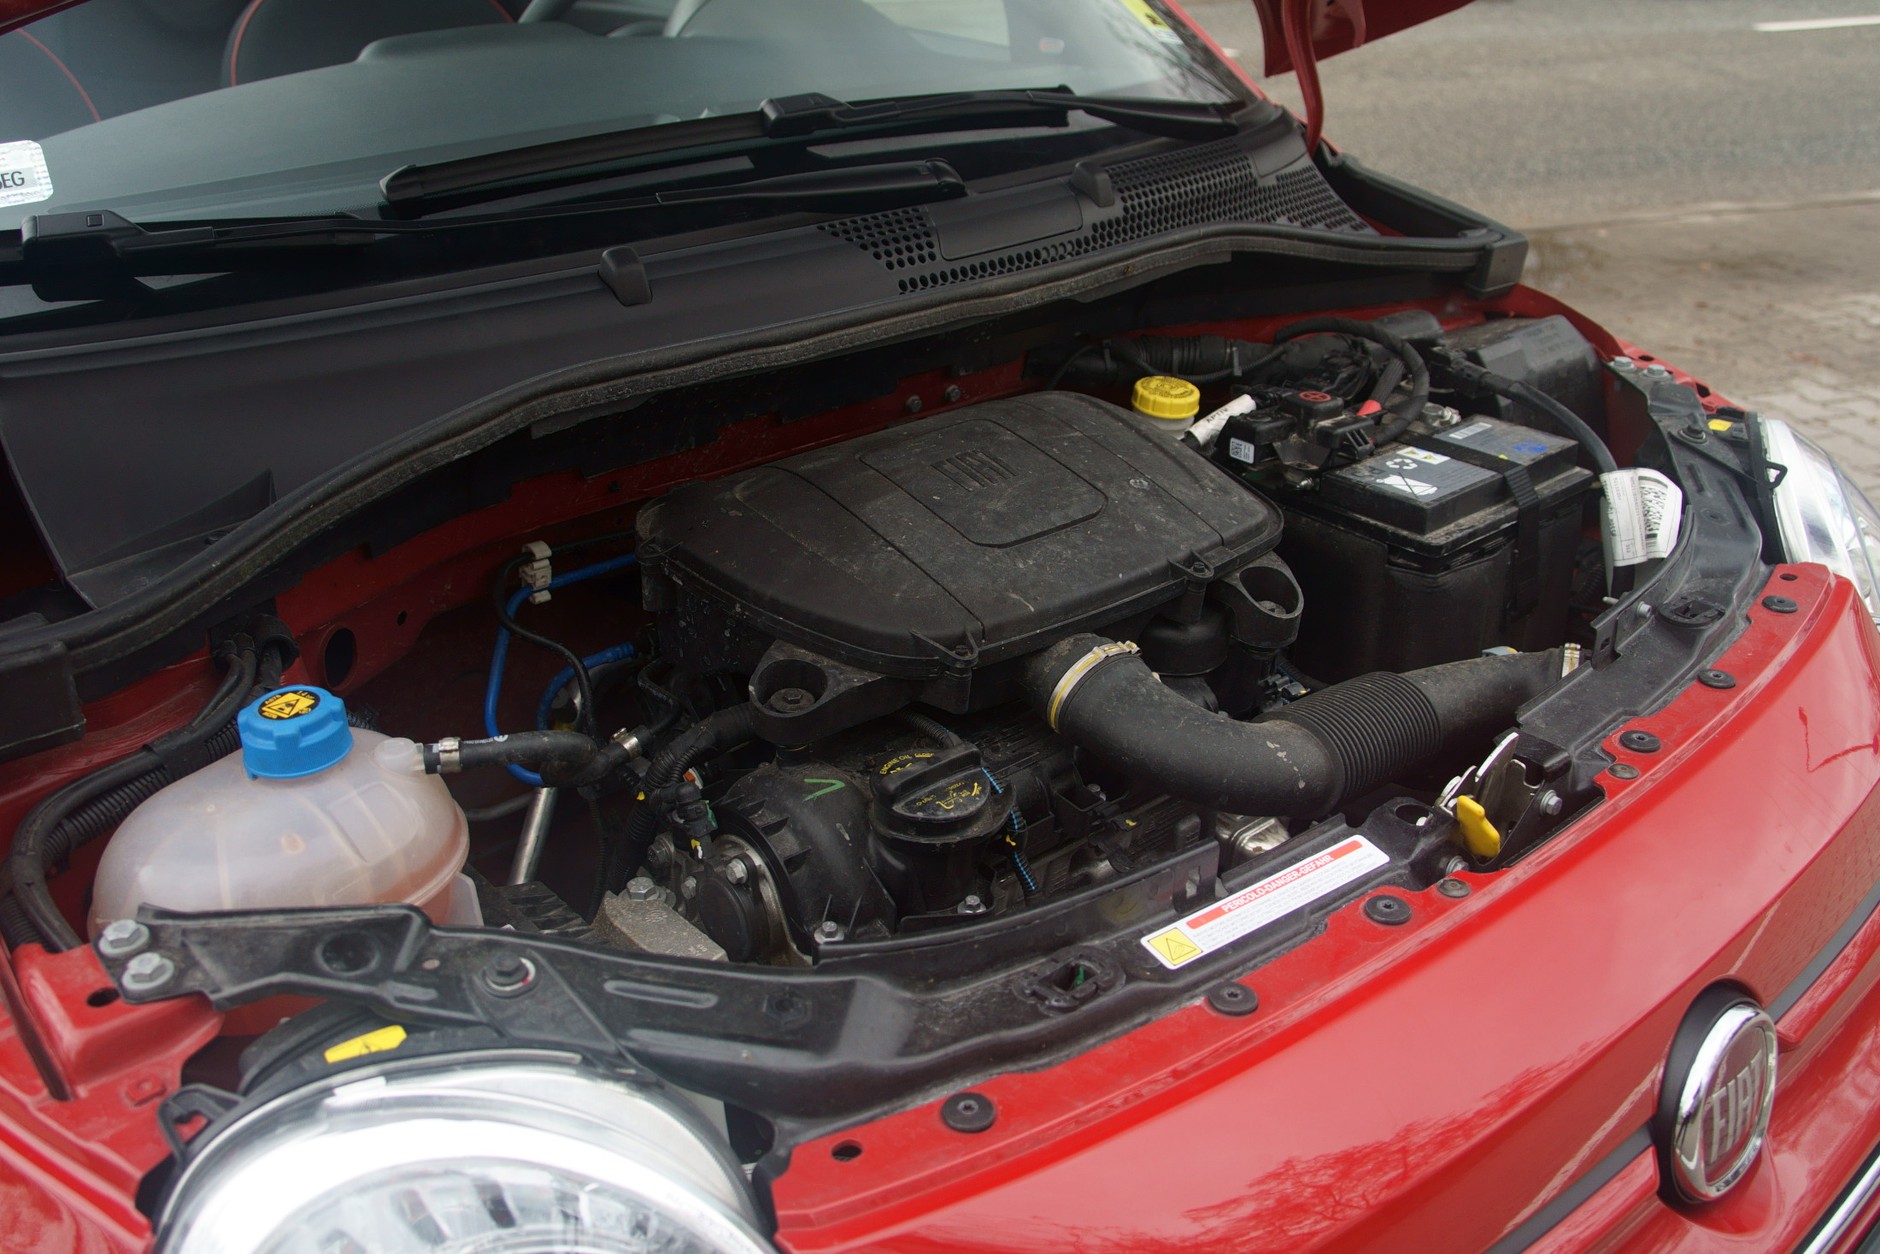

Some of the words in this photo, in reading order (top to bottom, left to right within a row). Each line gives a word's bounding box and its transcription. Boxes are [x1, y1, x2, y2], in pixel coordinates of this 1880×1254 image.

[930, 449, 1018, 493] FIAT
[880, 758, 900, 774] ENGINE
[1221, 854, 1335, 913] PERICOLO-DANGER-GEFAHR
[1710, 1049, 1763, 1164] FIAT
